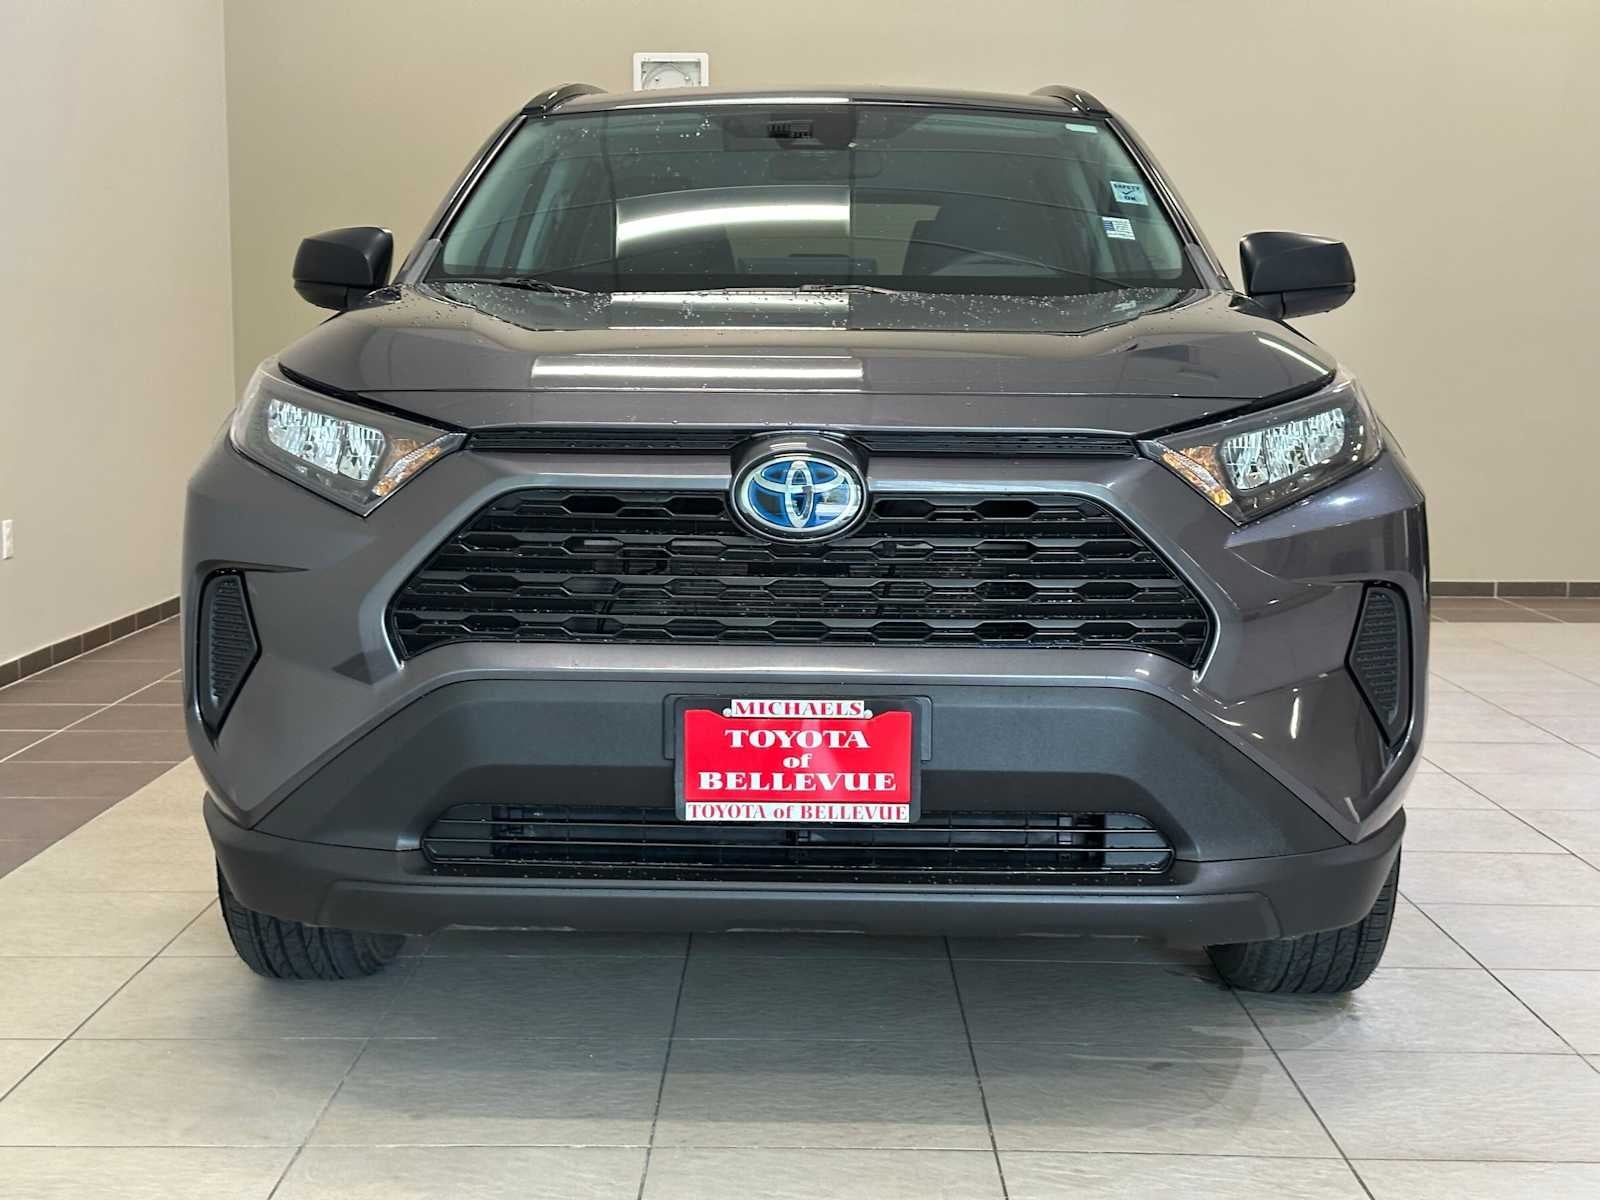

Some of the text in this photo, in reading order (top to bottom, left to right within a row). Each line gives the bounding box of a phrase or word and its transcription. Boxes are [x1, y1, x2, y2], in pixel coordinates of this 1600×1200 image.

[734, 702, 862, 716] MICHAELS
[725, 730, 870, 748] TOYOTA
[783, 753, 812, 768] of
[698, 772, 896, 791] BELLEVUE
[688, 805, 907, 820] TOYOTA of BELLEVUE
